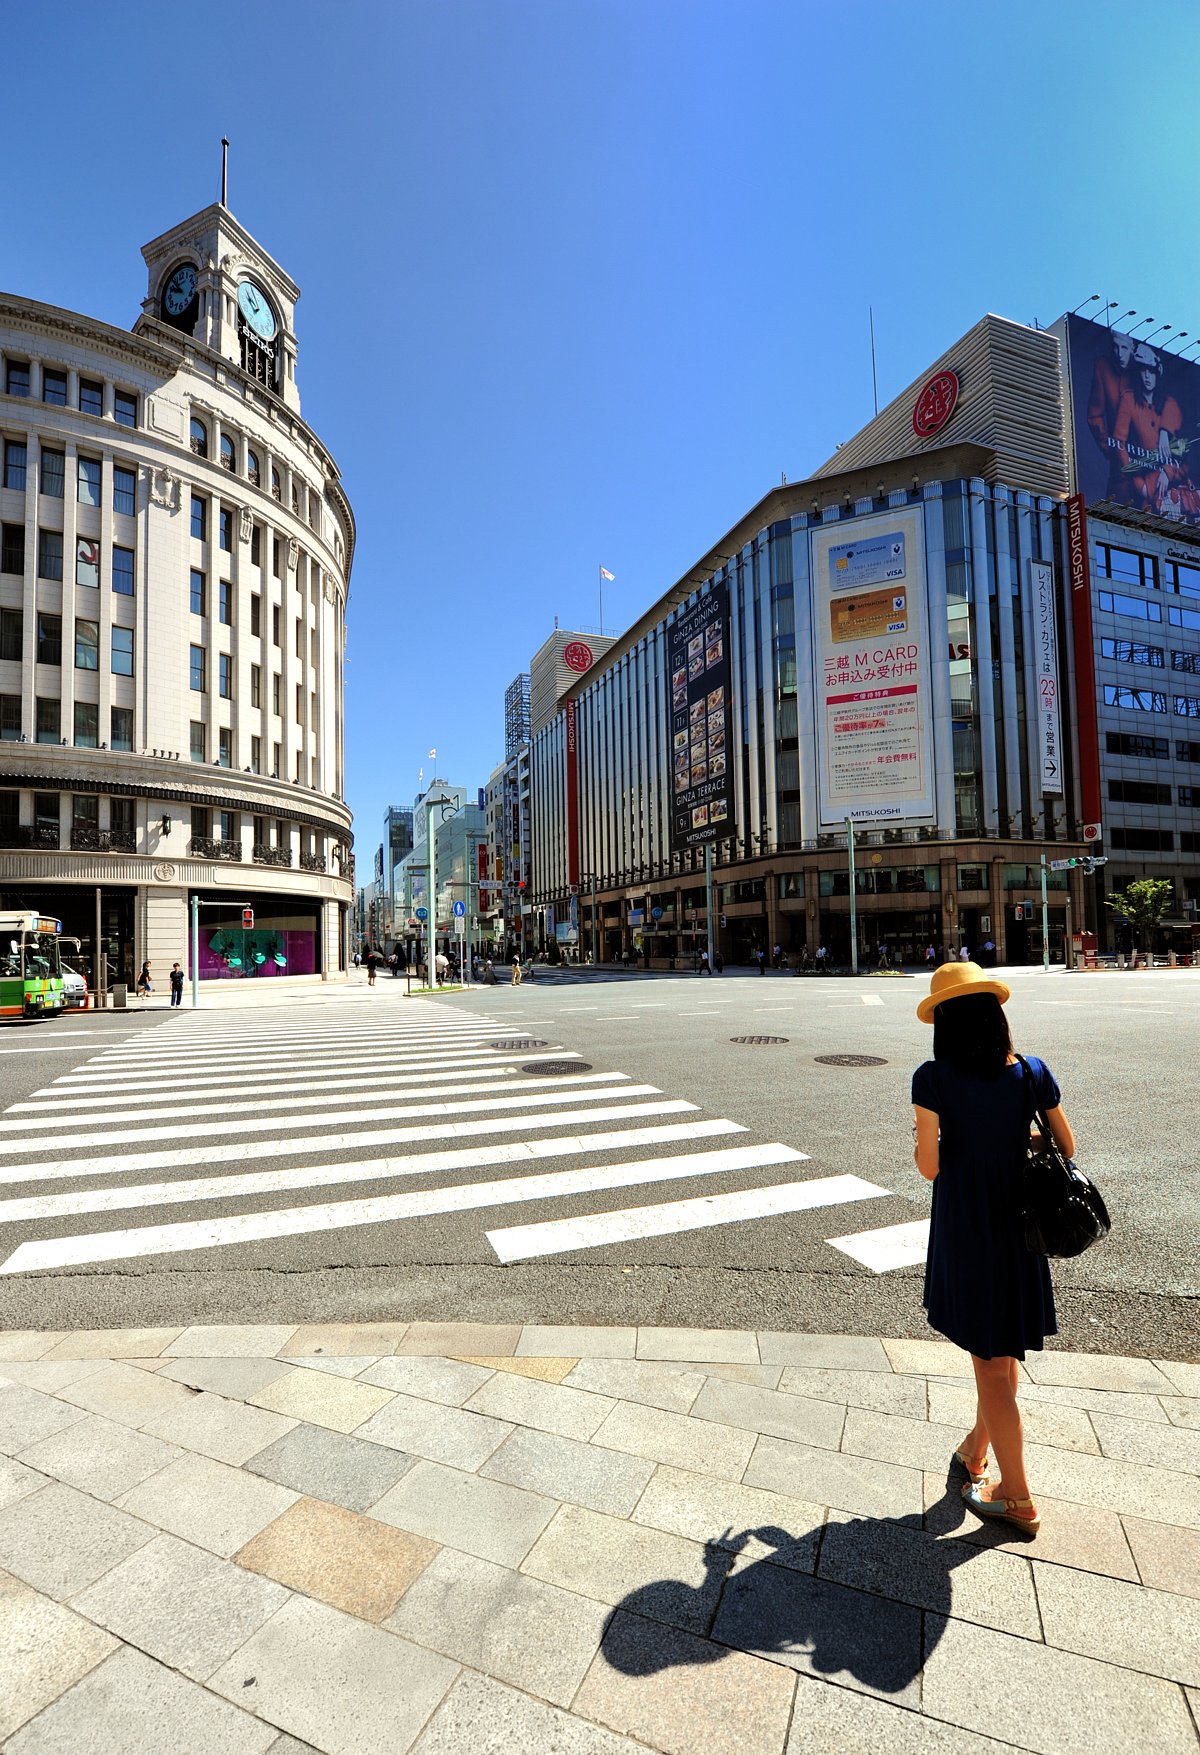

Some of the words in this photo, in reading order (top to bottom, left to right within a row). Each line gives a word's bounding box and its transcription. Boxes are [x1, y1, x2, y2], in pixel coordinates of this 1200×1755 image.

[242, 325, 275, 359] SEIKO
[1107, 437, 1181, 469] BURBERRY
[1070, 501, 1084, 590] MITSUKOSHI
[886, 568, 903, 577] VISA
[673, 624, 693, 644] GINZA
[694, 600, 719, 627] DINING
[888, 622, 905, 631] VISA
[823, 655, 850, 671] 三越
[855, 652, 868, 667] M
[872, 644, 918, 664] CARD
[825, 661, 918, 687] お申込み受付中
[853, 689, 889, 701] ご優待特典
[877, 752, 917, 764] 年会費無料
[676, 791, 696, 806] GINZA
[697, 778, 726, 798] TERRACE
[851, 807, 901, 817] MITSUKOSHI
[686, 827, 717, 843] MITSUKOSHI
